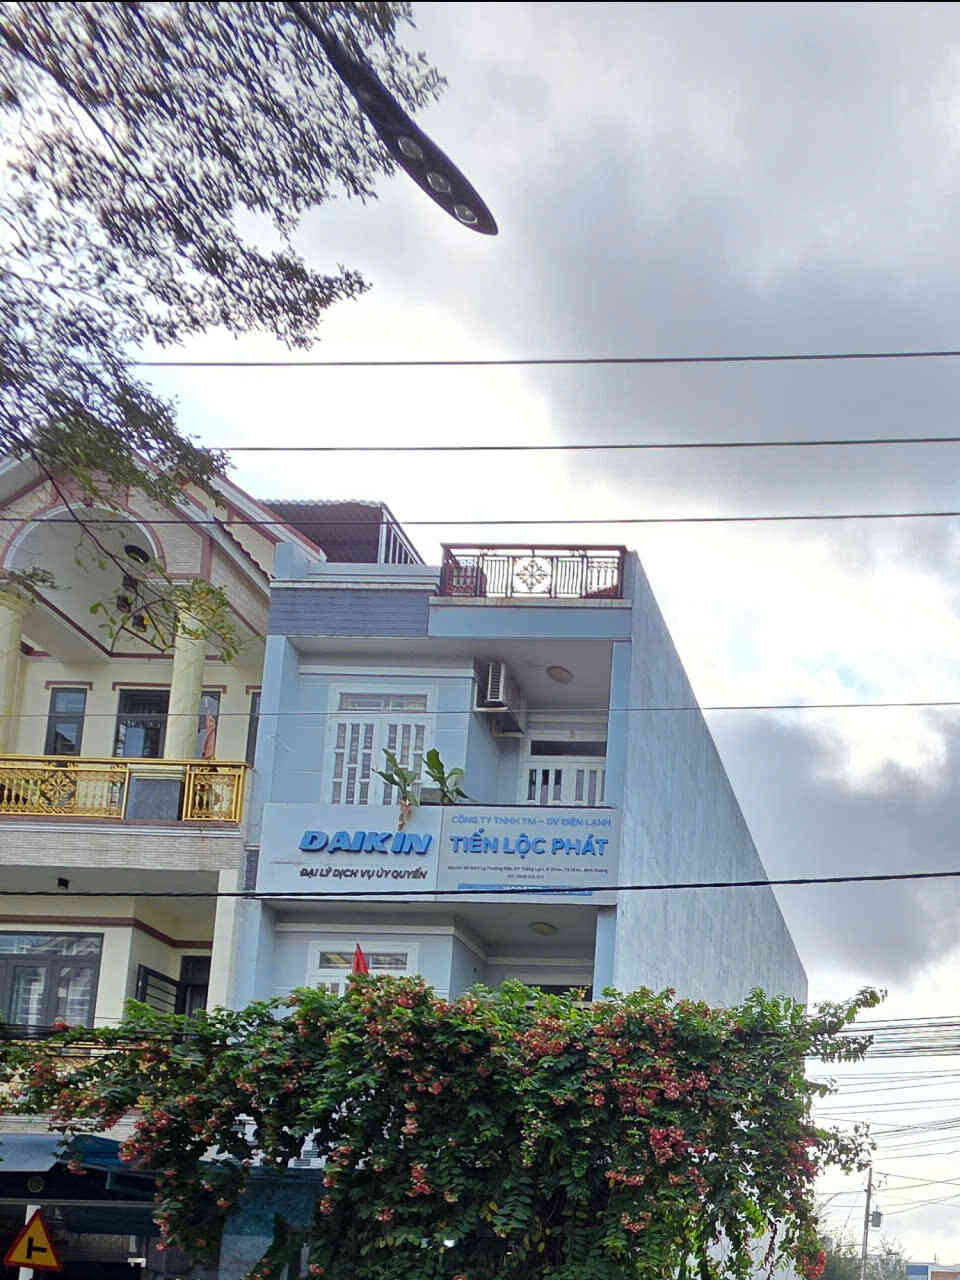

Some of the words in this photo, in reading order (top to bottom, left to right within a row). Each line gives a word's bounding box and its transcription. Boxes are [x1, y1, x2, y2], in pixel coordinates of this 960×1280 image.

[452, 814, 478, 825] CÔNG
[480, 816, 491, 825] TY
[299, 830, 432, 855] DAIKIN
[450, 828, 499, 854] TIẾN
[503, 833, 546, 859] LỘC
[551, 834, 609, 856] PHÁT
[300, 868, 318, 879] ĐẠI
[319, 866, 332, 878] LÝ
[333, 869, 358, 880] DỊCH
[360, 869, 375, 880] VỤ
